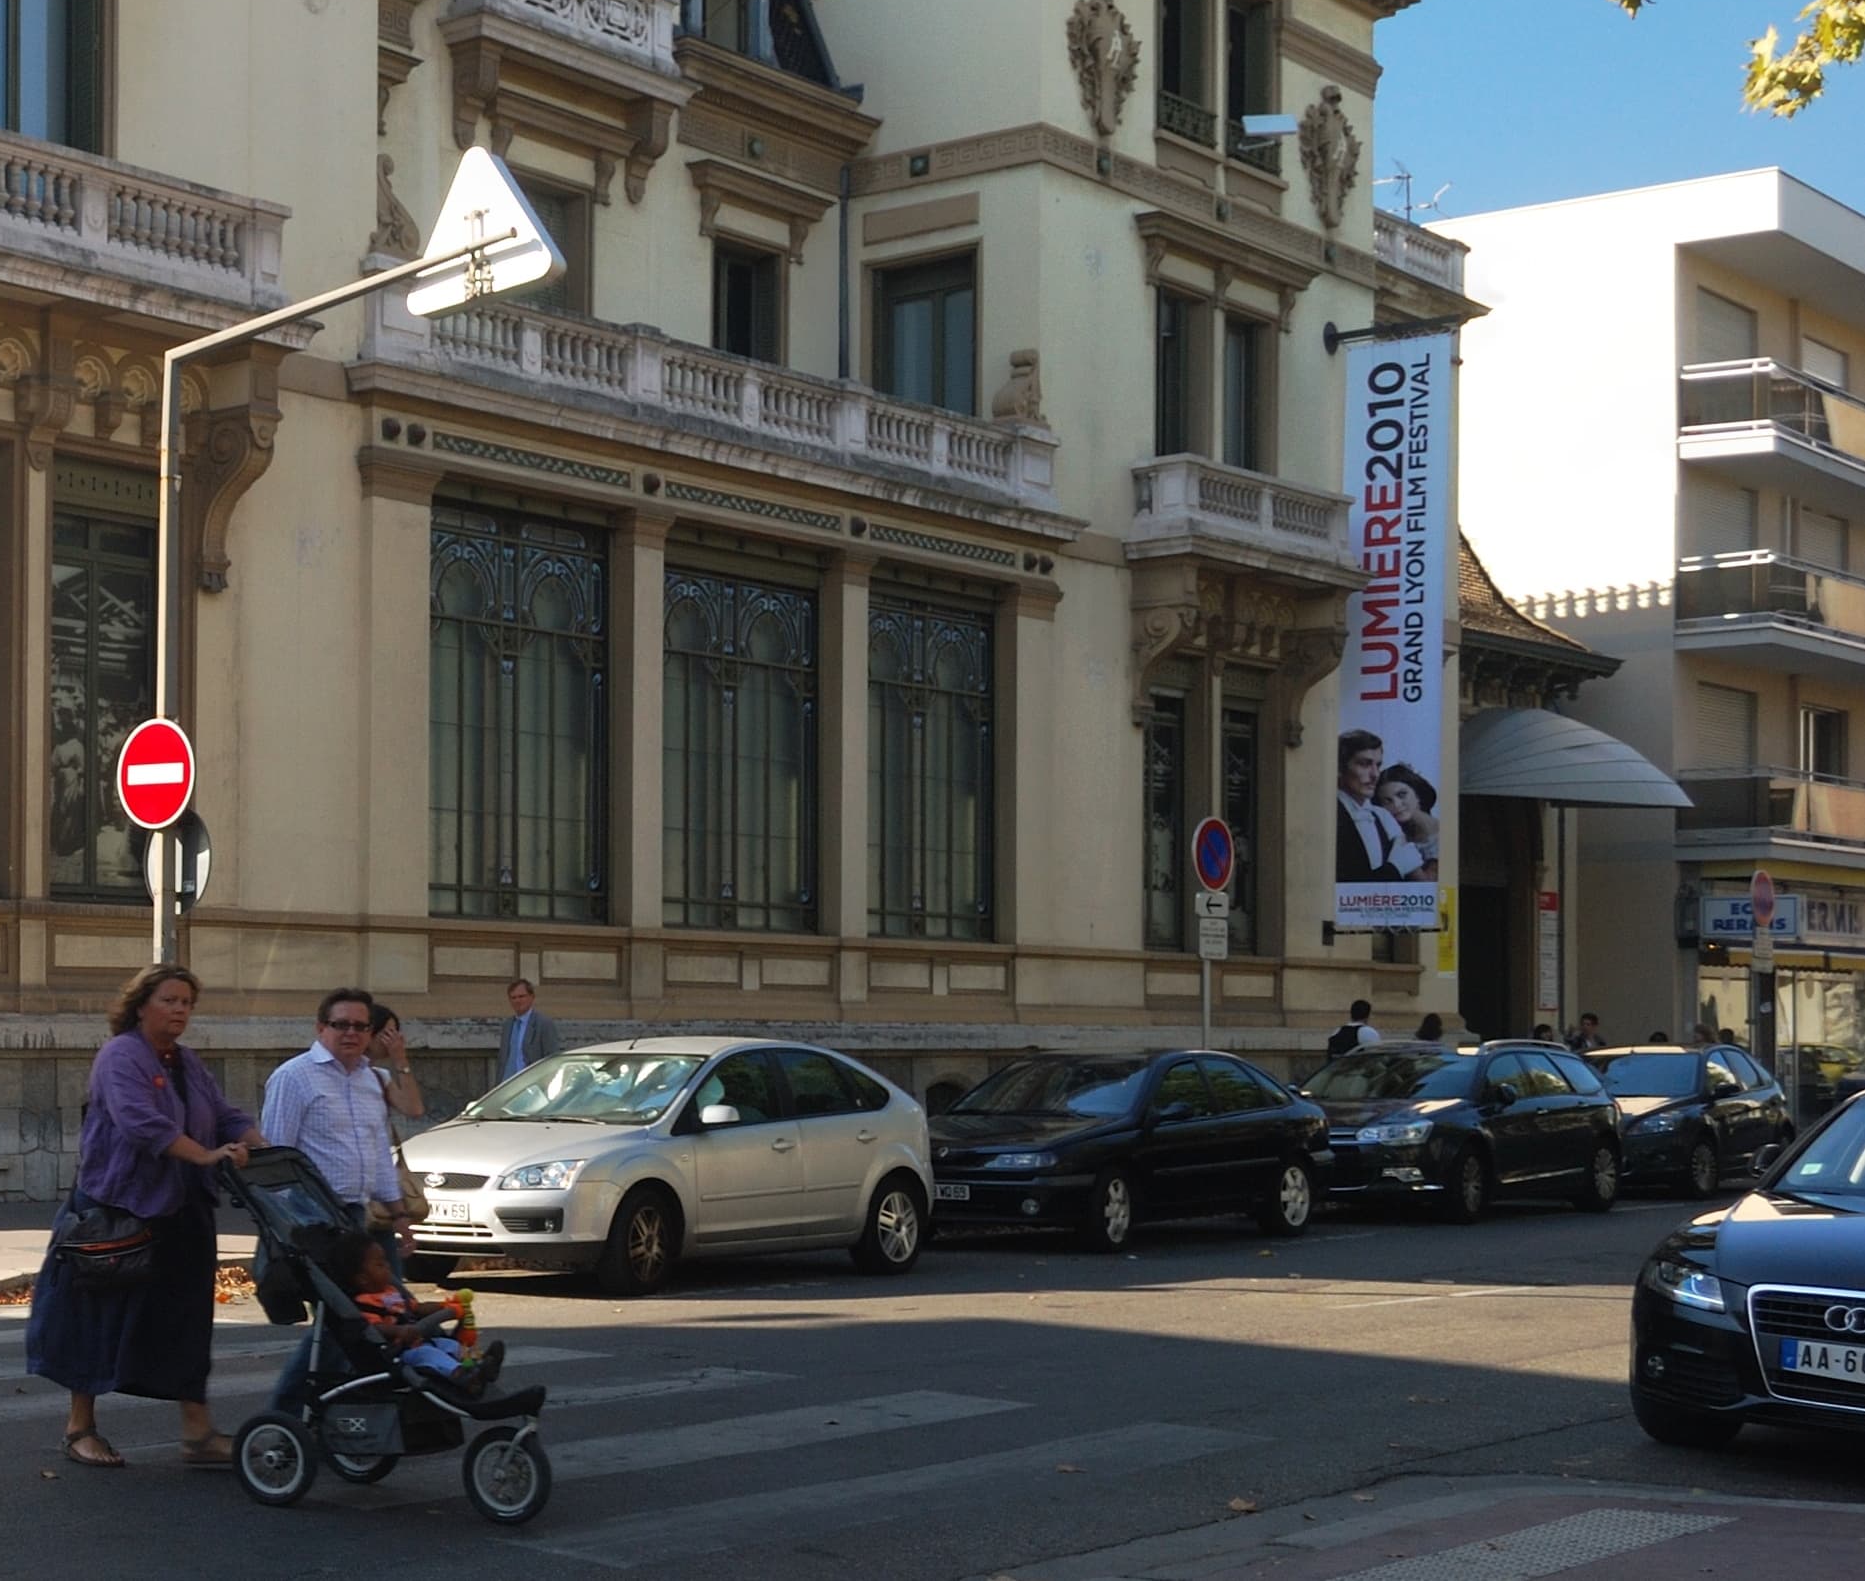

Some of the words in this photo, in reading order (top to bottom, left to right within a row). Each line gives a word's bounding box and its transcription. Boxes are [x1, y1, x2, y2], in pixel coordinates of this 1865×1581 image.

[1408, 353, 1430, 470] FESTIVAL
[1407, 476, 1427, 533] FILM
[1405, 539, 1426, 605] LYON
[1403, 611, 1424, 703] GRAND
[451, 1204, 466, 1218] 69
[1800, 1344, 1865, 1375] AA-6
